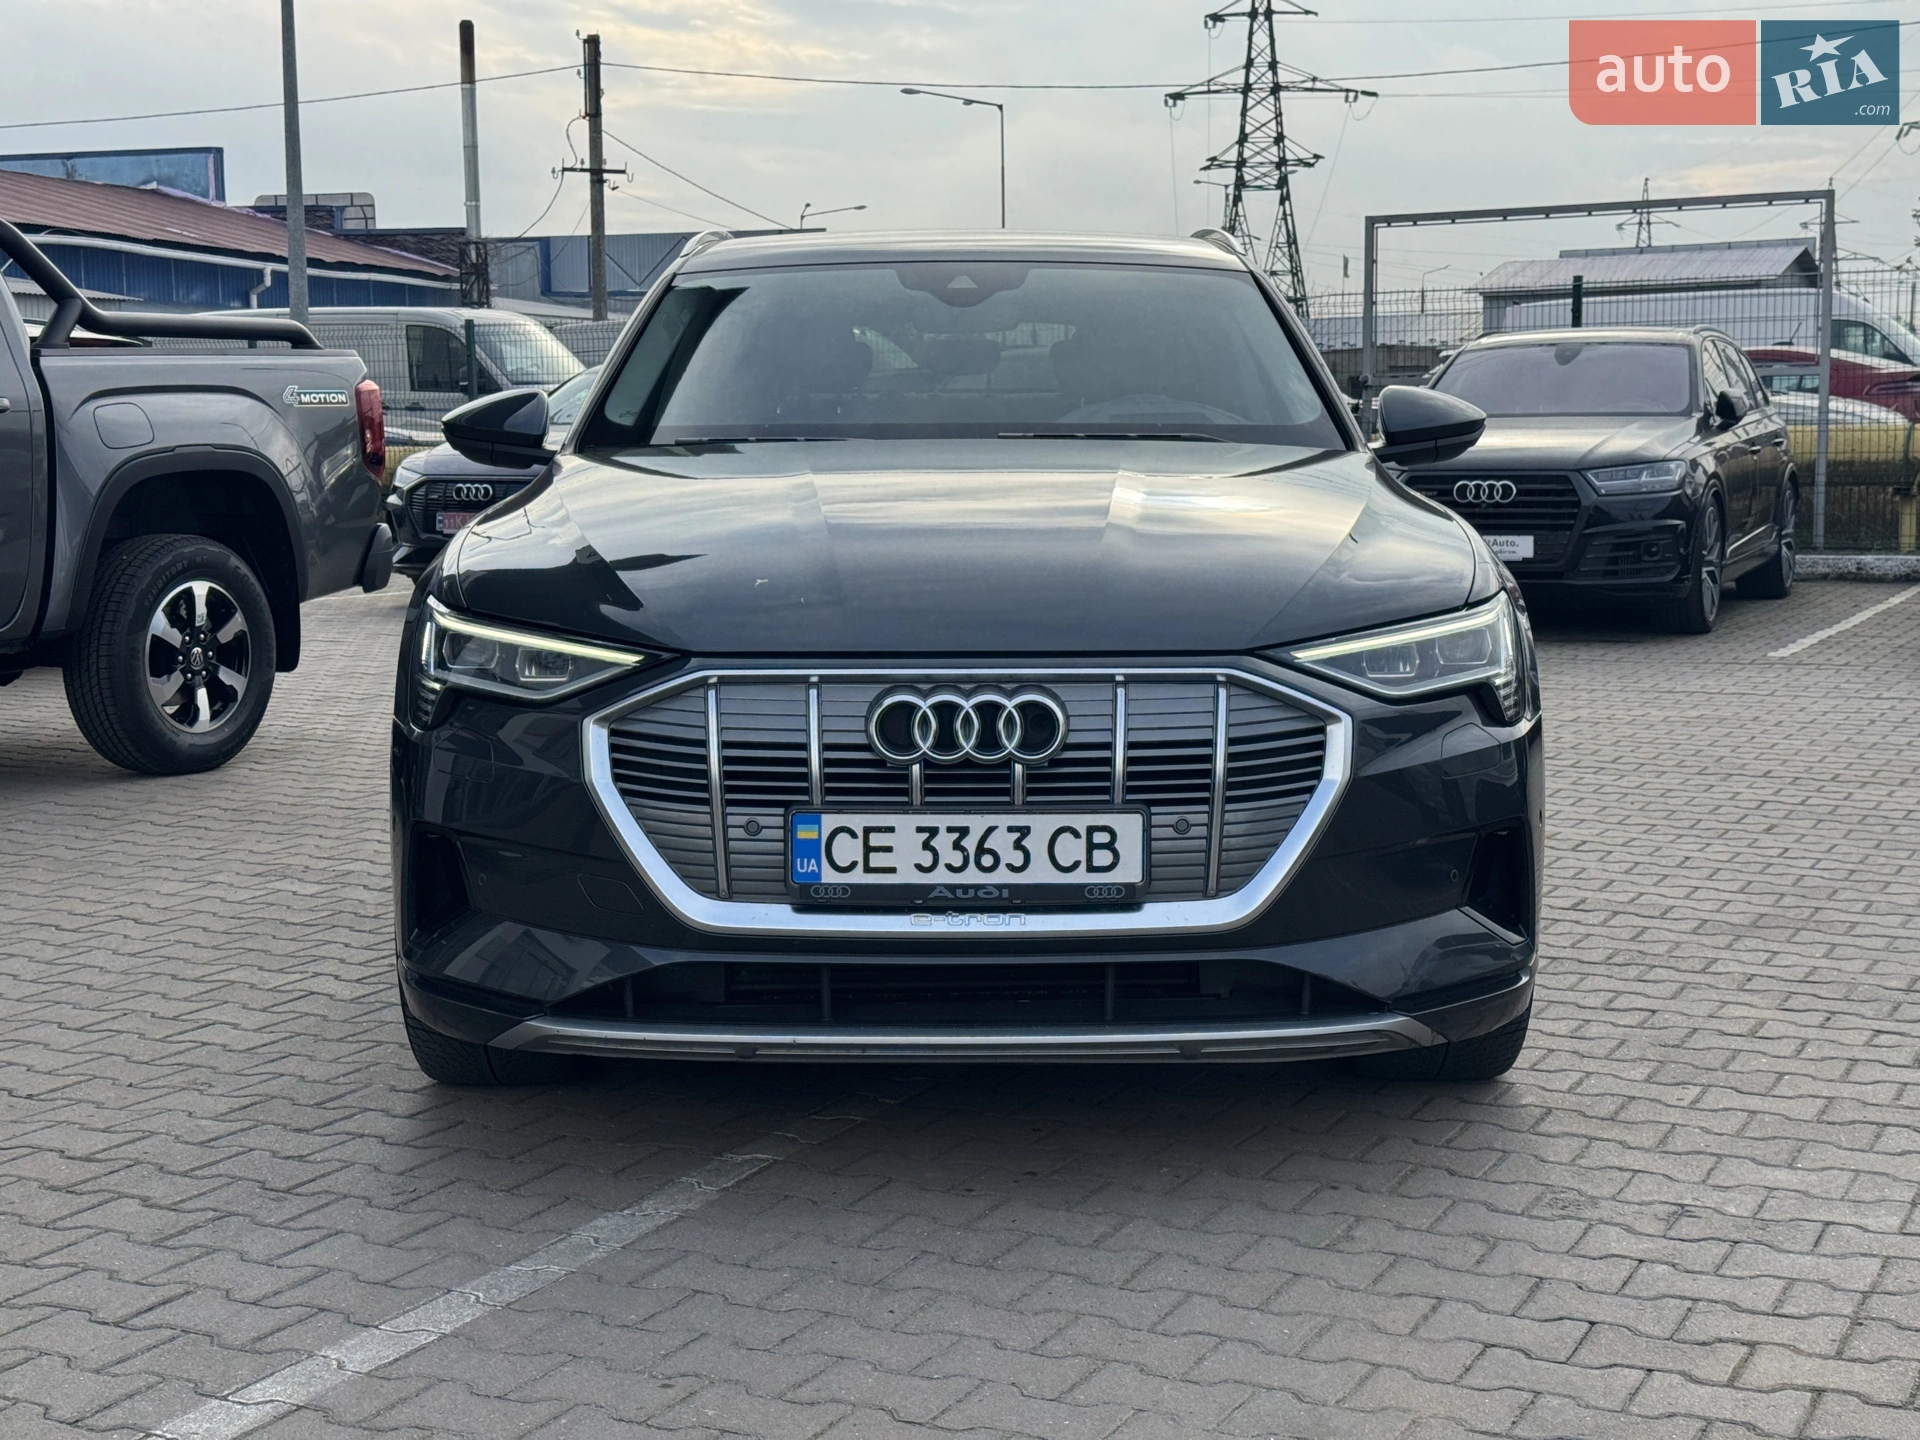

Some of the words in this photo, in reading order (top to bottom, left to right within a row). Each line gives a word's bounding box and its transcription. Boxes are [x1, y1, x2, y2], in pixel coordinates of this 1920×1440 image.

[282, 385, 348, 406] 4MOTION
[796, 858, 819, 873] UA
[824, 825, 897, 874] CE
[913, 825, 1032, 874] 3363
[1047, 825, 1121, 874] CB
[927, 885, 1009, 899] Audi
[909, 911, 1026, 926] e-tron
